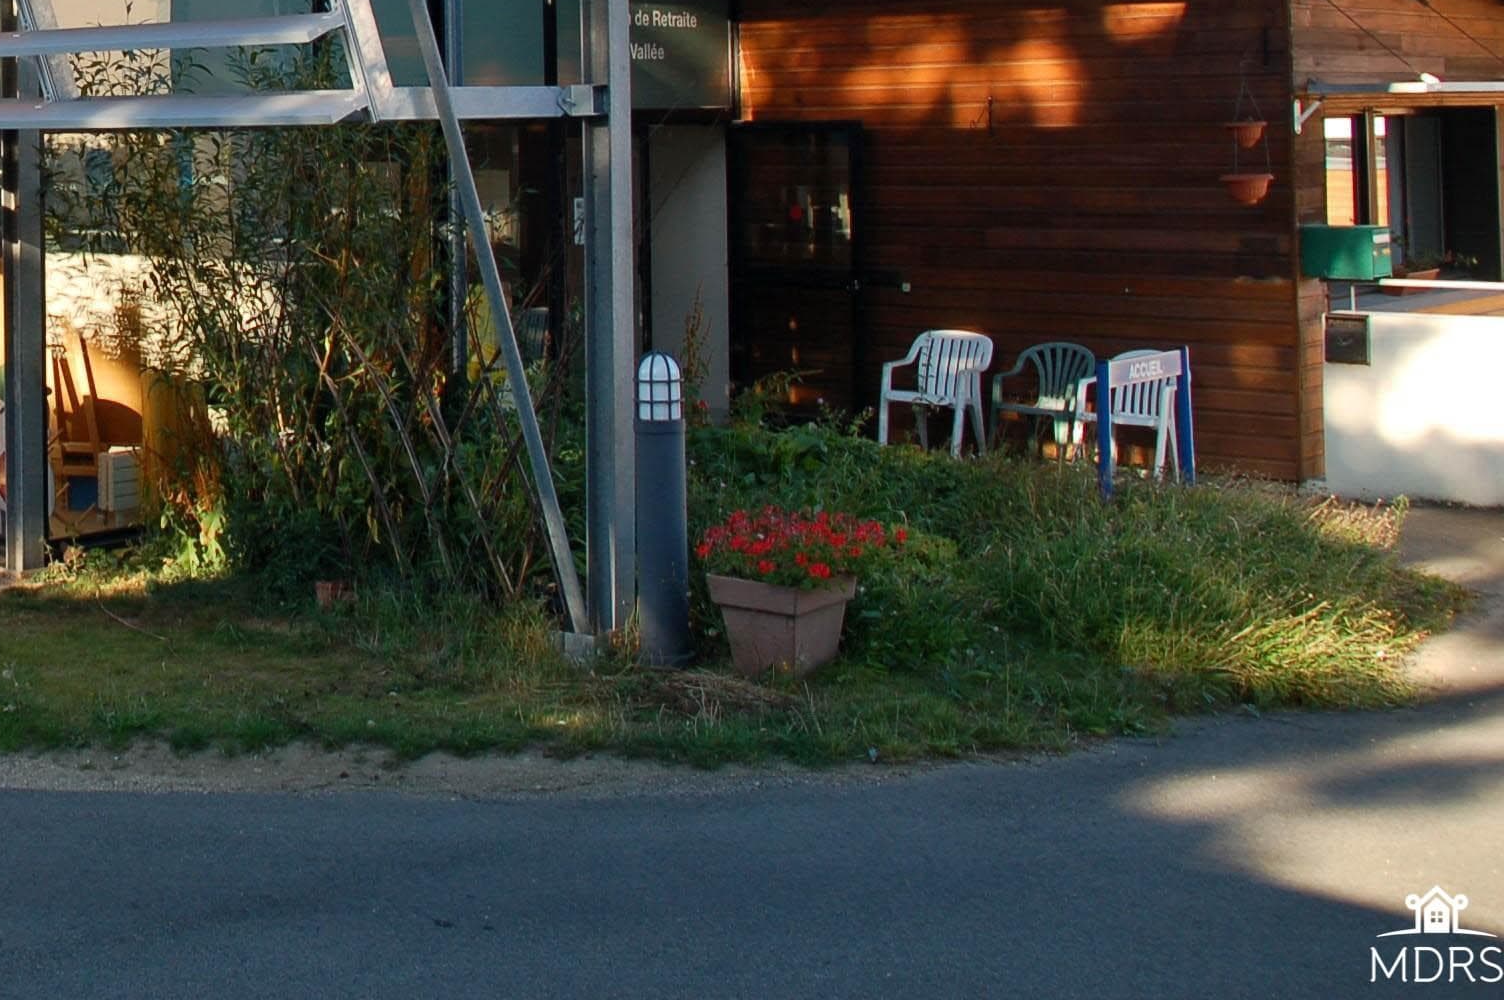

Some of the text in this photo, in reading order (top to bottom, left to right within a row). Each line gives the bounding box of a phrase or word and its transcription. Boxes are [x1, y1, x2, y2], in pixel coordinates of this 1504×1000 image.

[634, 9, 650, 26] de
[652, 10, 697, 28] Retraite
[629, 43, 665, 60] Vallée
[1129, 360, 1164, 380] ACCUEIL
